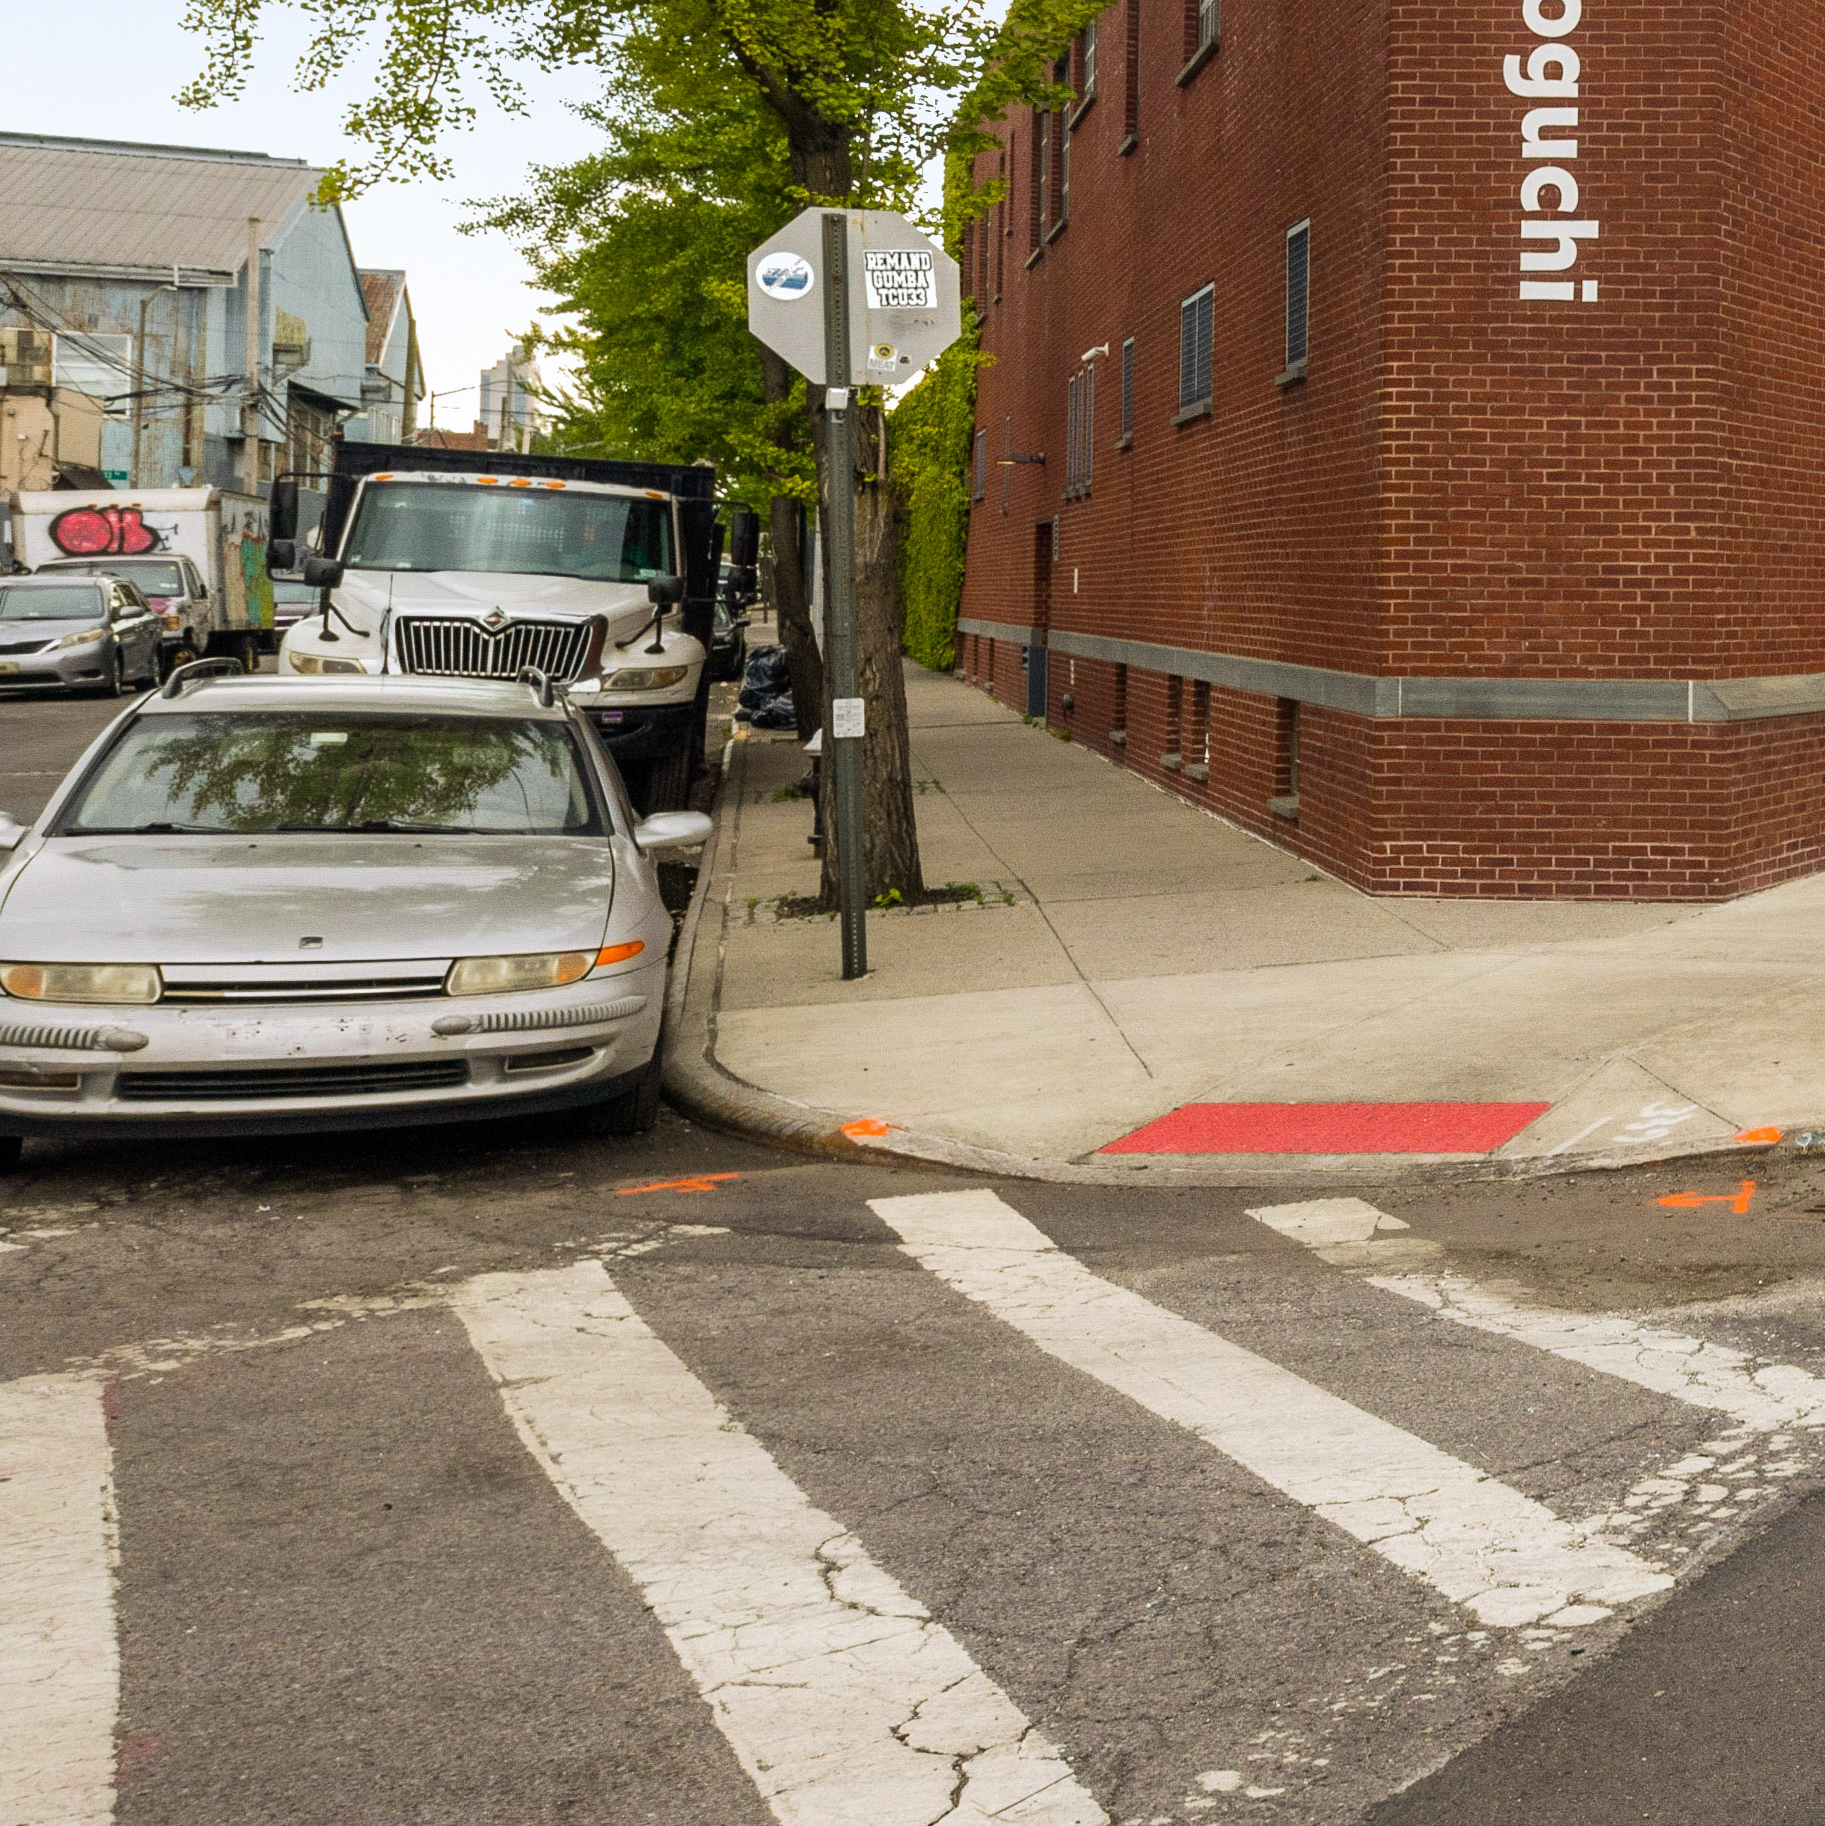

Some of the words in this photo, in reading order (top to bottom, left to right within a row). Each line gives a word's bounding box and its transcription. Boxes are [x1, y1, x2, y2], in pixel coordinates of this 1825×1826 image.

[865, 251, 931, 271] REMAND
[872, 270, 928, 289] GUMBA
[878, 288, 927, 306] TCU33
